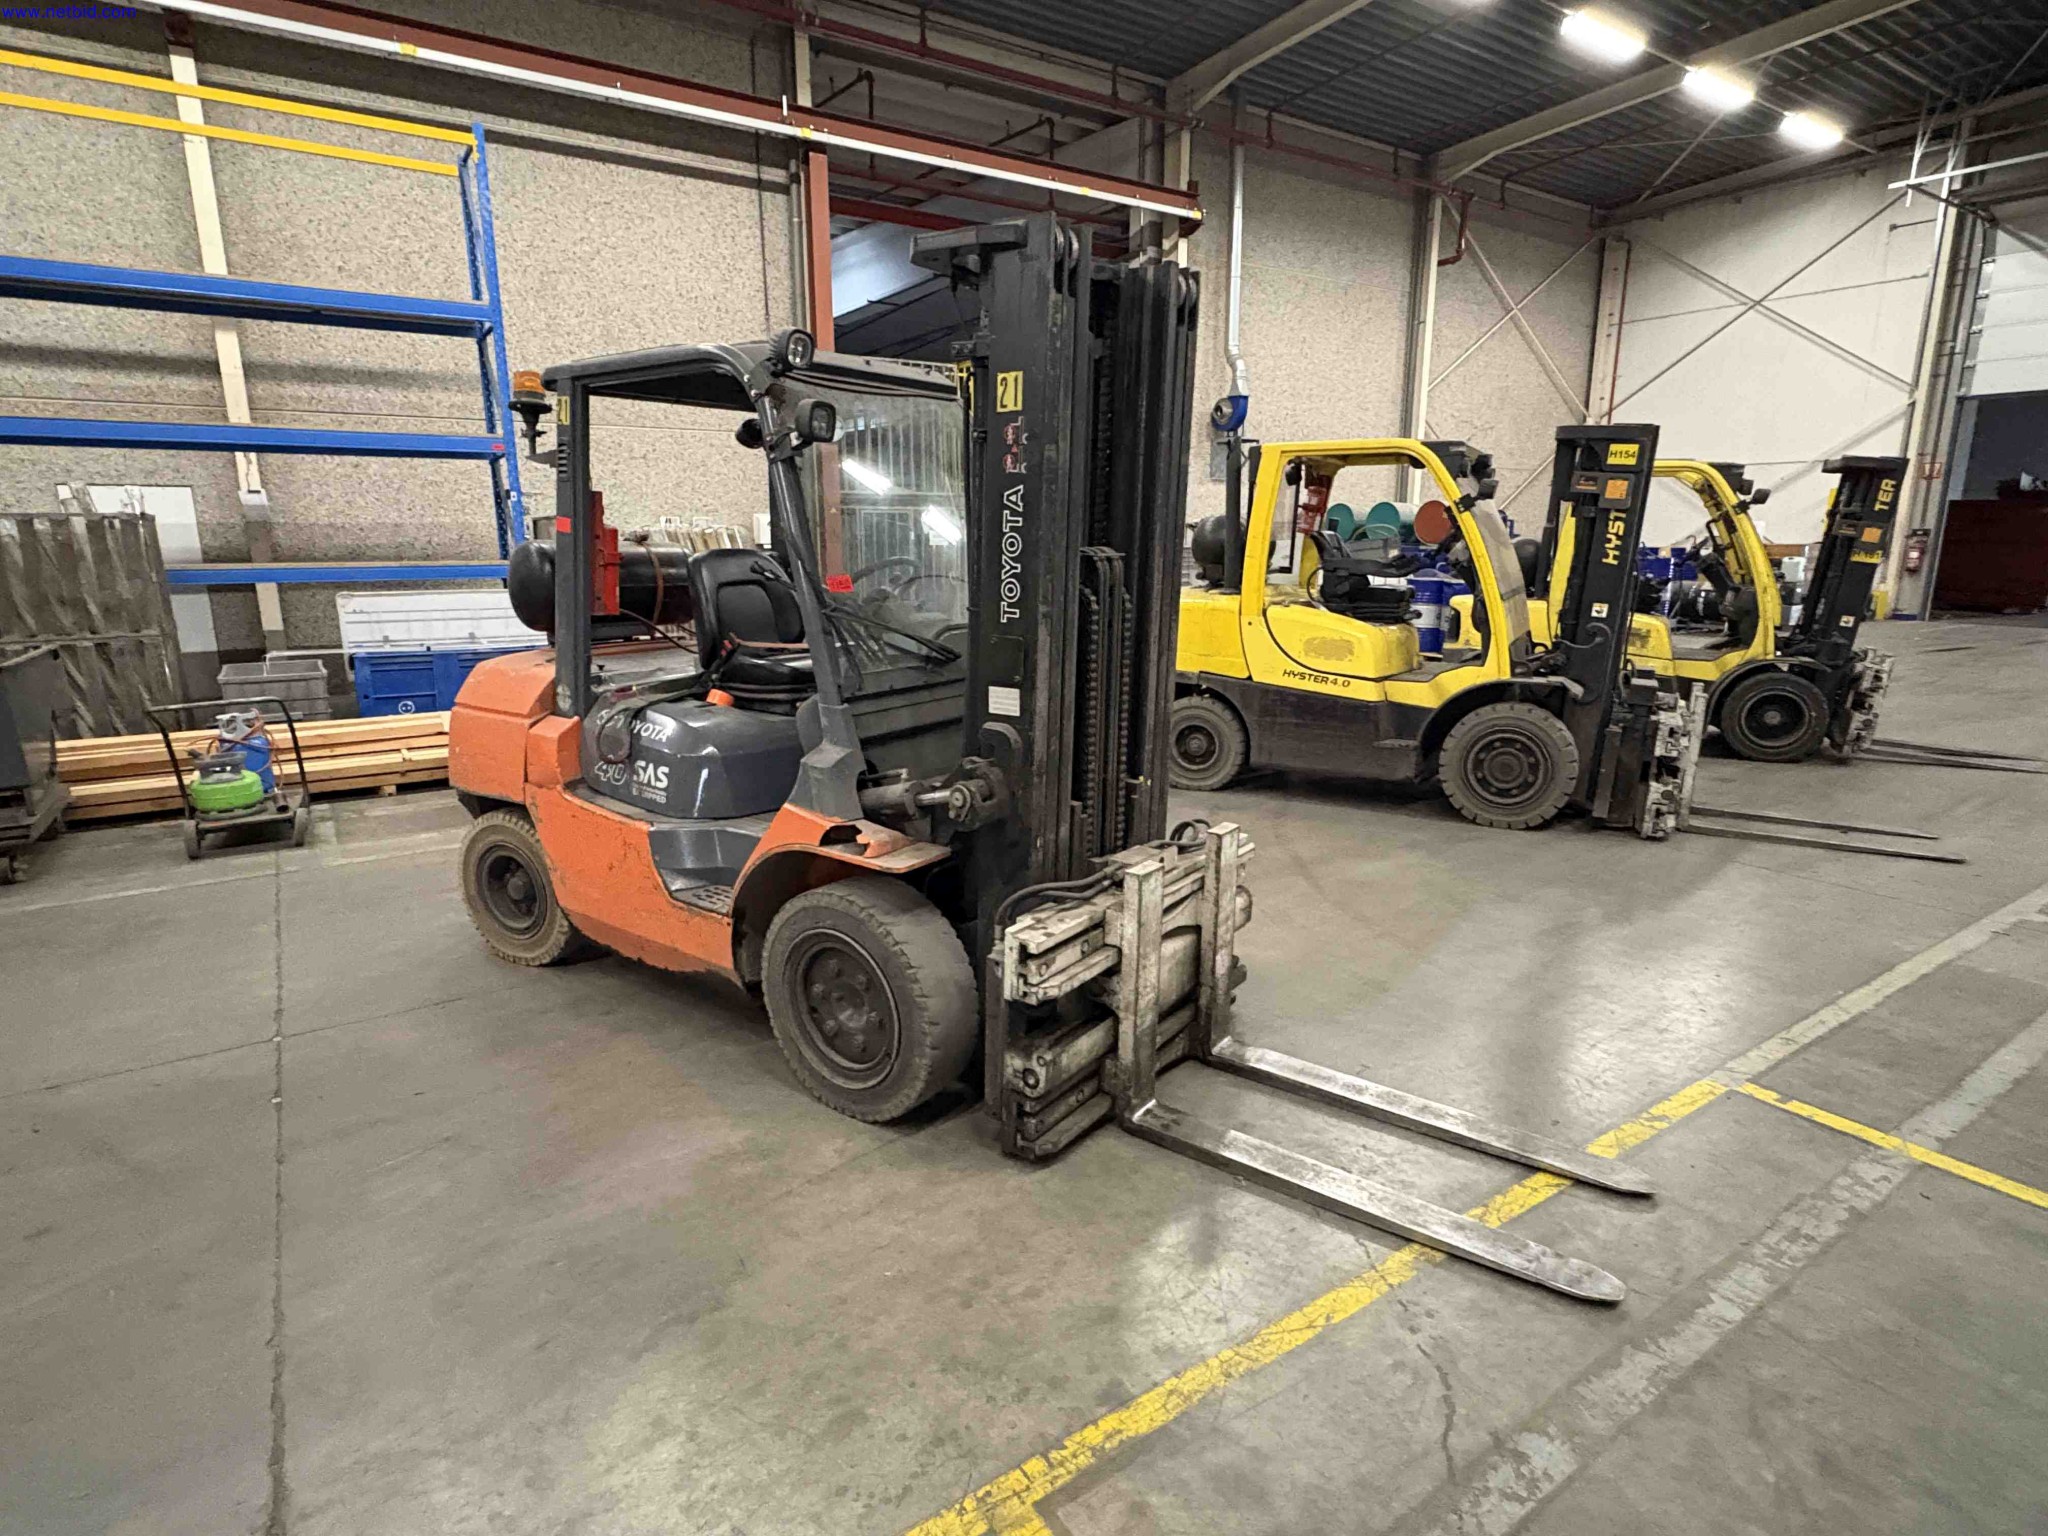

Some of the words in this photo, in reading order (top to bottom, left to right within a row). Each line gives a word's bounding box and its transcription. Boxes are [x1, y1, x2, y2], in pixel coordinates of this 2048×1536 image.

[1000, 374, 1018, 408] 21
[1608, 449, 1637, 459] H154
[1001, 484, 1024, 623] TOYOTA
[1282, 669, 1330, 685] HYSTER
[633, 760, 670, 789] SAS
